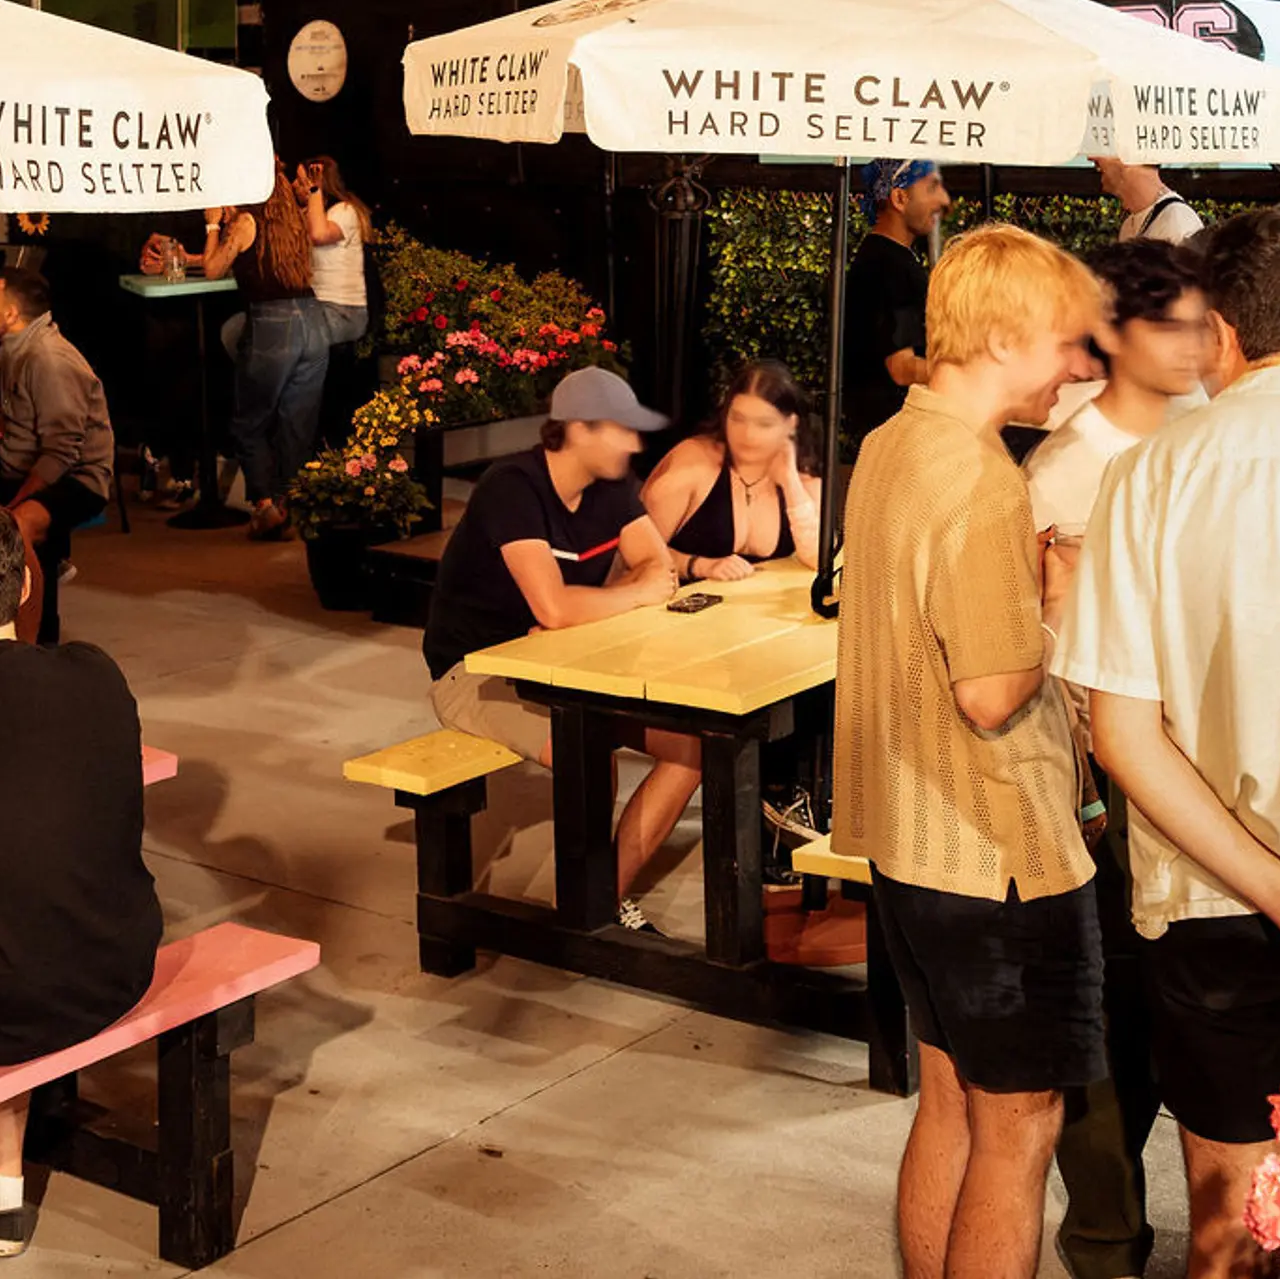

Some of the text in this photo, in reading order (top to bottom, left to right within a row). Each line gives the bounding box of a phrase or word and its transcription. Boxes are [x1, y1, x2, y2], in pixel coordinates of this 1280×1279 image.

[430, 55, 491, 88] WHITE
[661, 68, 826, 104] WHITE
[428, 94, 474, 120] HARD
[478, 88, 538, 115] SELTZER
[1133, 84, 1198, 117] WHITE
[667, 109, 987, 148] HARD SELTZER
[1189, 125, 1260, 151] SELTZER
[81, 161, 203, 195] SELTZER
